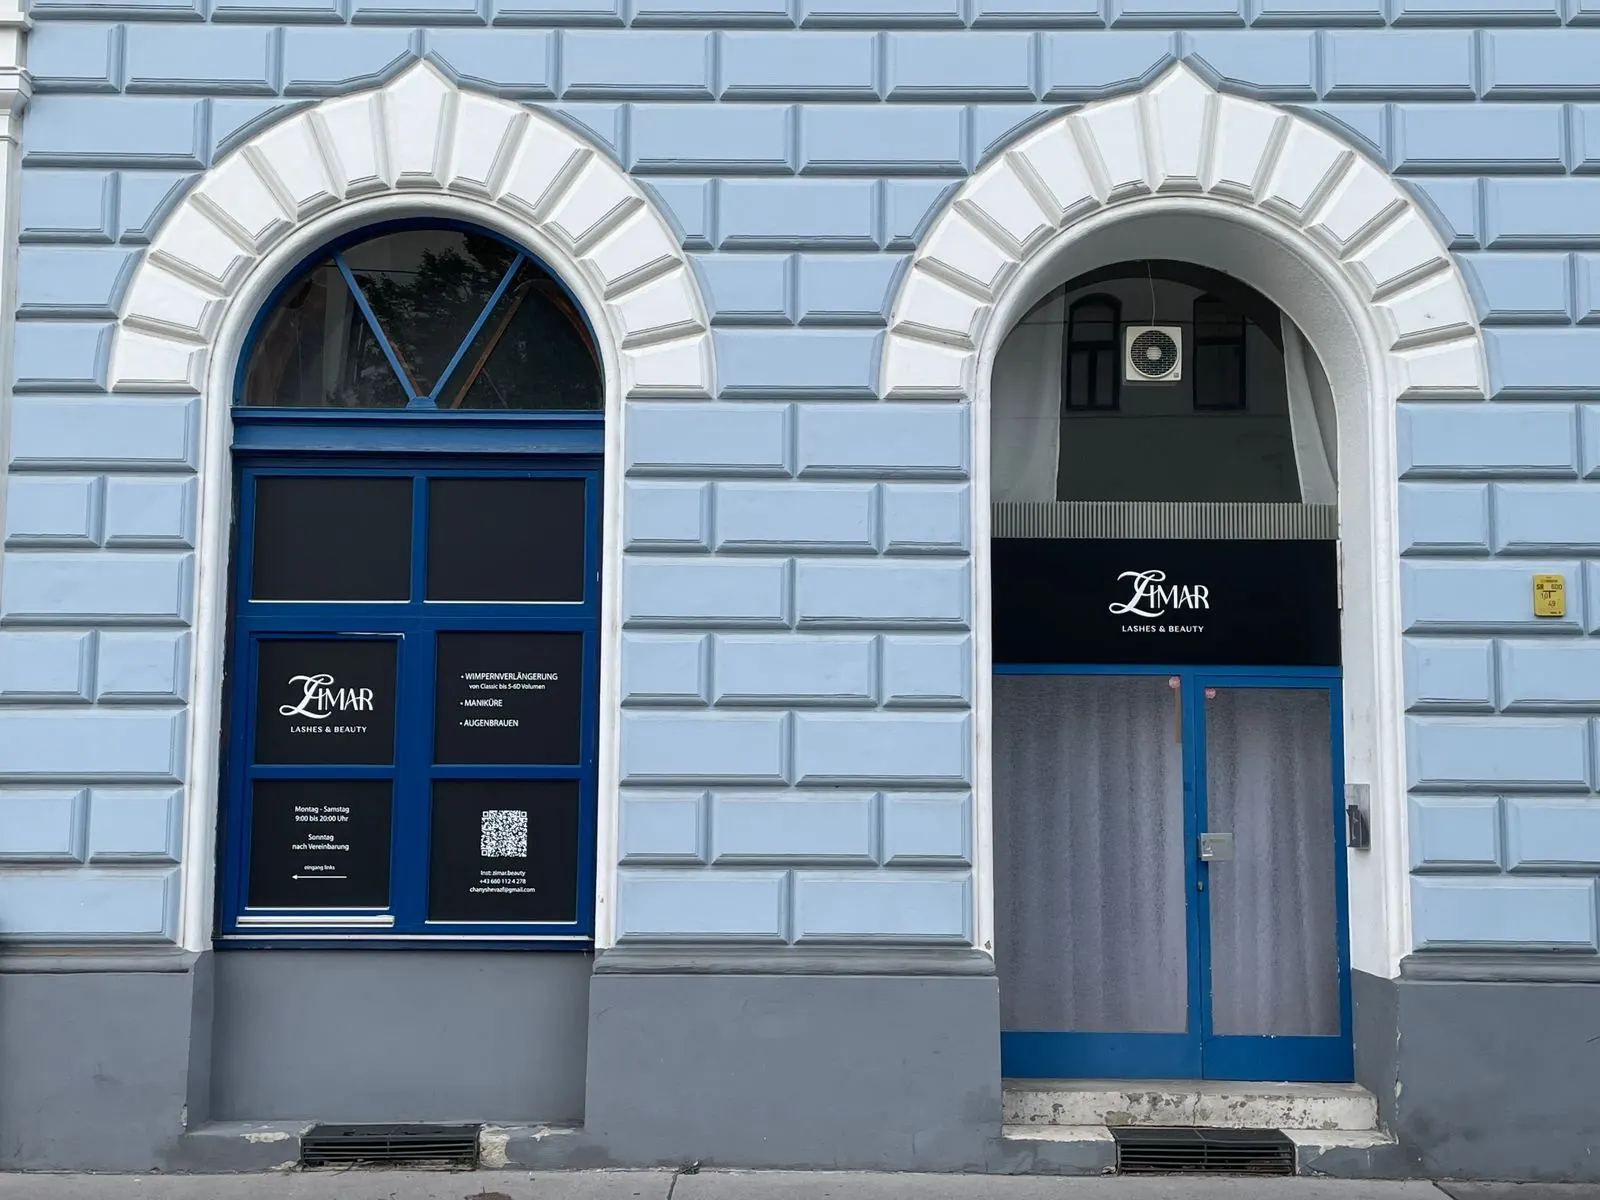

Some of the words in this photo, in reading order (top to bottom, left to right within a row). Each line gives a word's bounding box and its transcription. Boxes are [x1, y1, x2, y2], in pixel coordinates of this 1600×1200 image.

[1109, 569, 1210, 618] ZIMAR
[1121, 625, 1157, 633] LASHES
[1159, 625, 1166, 633] &
[1168, 625, 1204, 633] BEAUTY
[465, 672, 558, 681] WIMPERNVERLÄNGERUNG
[279, 674, 374, 720] ZIMAR
[464, 698, 503, 707] MANIKÜRE
[463, 719, 519, 727] AUGENBRAUEN
[294, 806, 319, 814] Montag
[323, 806, 350, 814] Samstag
[308, 843, 350, 852] Vereinbarung
